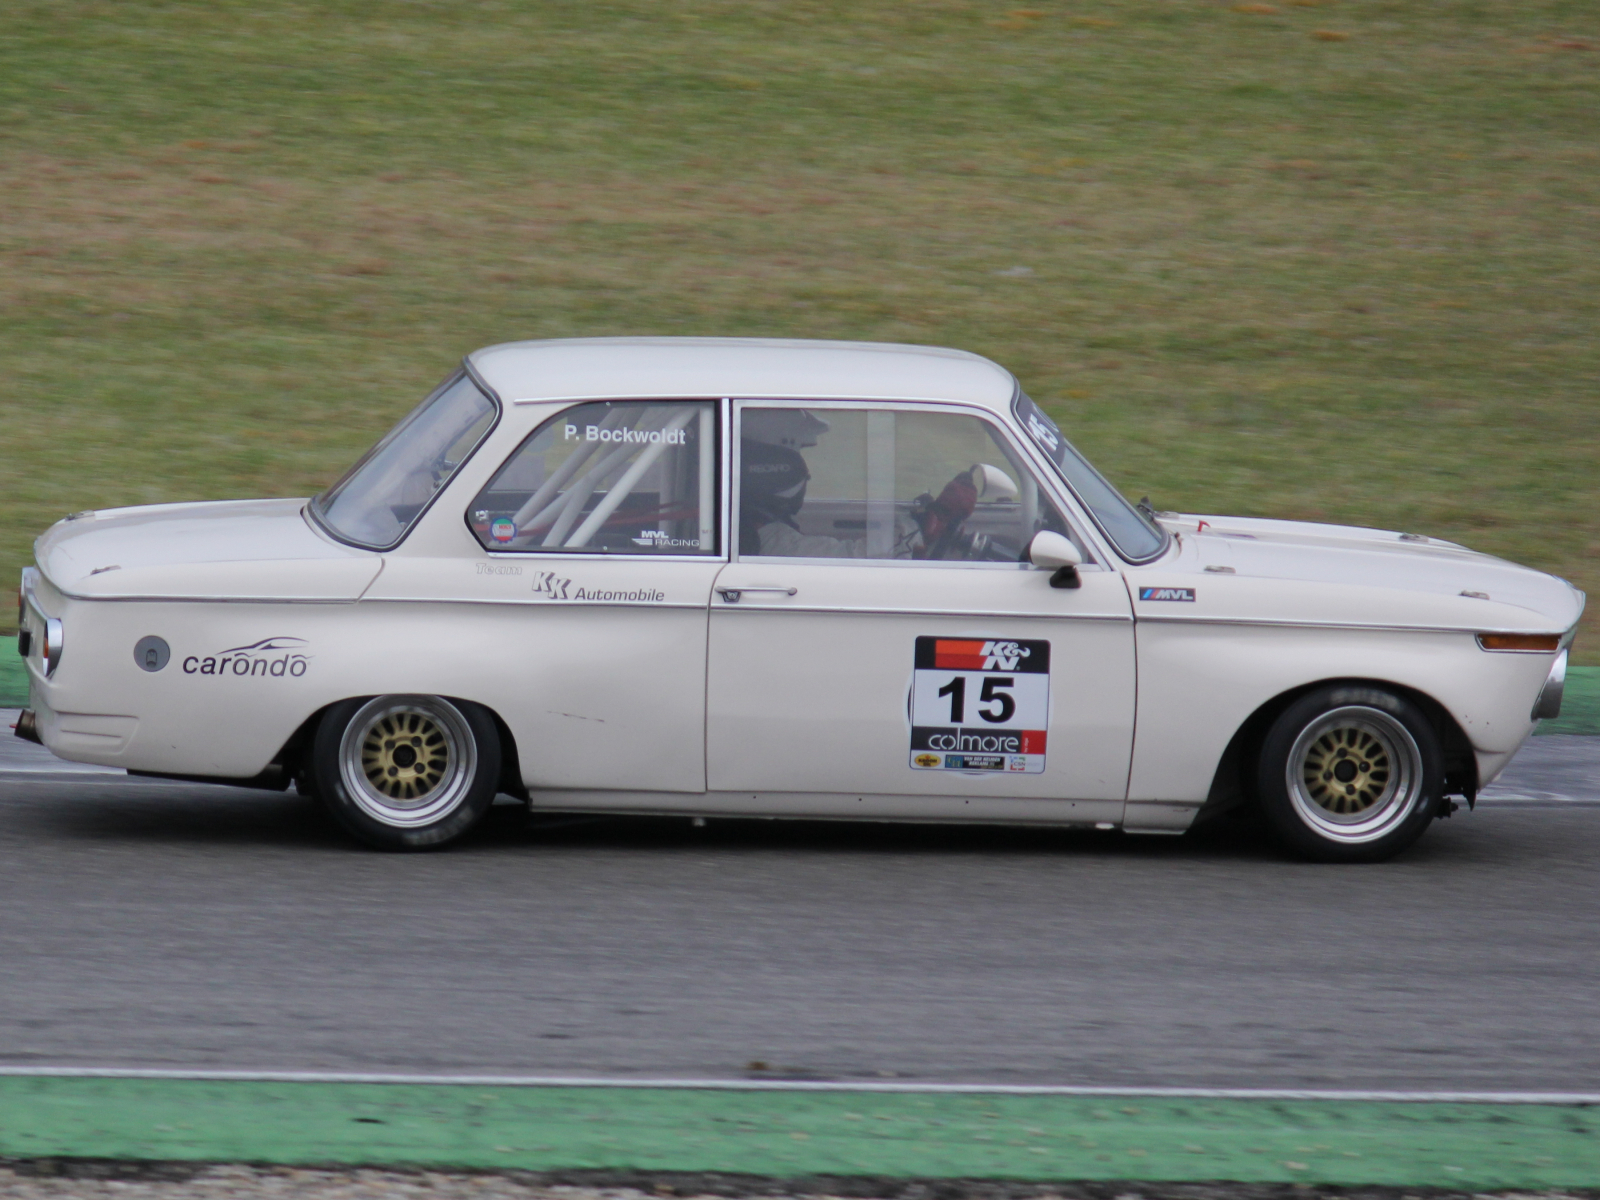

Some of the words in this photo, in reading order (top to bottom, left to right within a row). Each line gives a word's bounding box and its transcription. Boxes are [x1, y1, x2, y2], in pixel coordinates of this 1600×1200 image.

[564, 424, 580, 441] P.
[585, 425, 686, 445] Bockwoldt
[1028, 413, 1059, 452] 15
[641, 530, 669, 539] MVL
[655, 538, 700, 547] RACING
[475, 562, 523, 576] Team
[574, 587, 665, 602] Automobile
[1155, 588, 1194, 600] MVL
[979, 641, 1031, 671] K&N
[938, 676, 1016, 724] 15
[928, 727, 1019, 753] colmore
